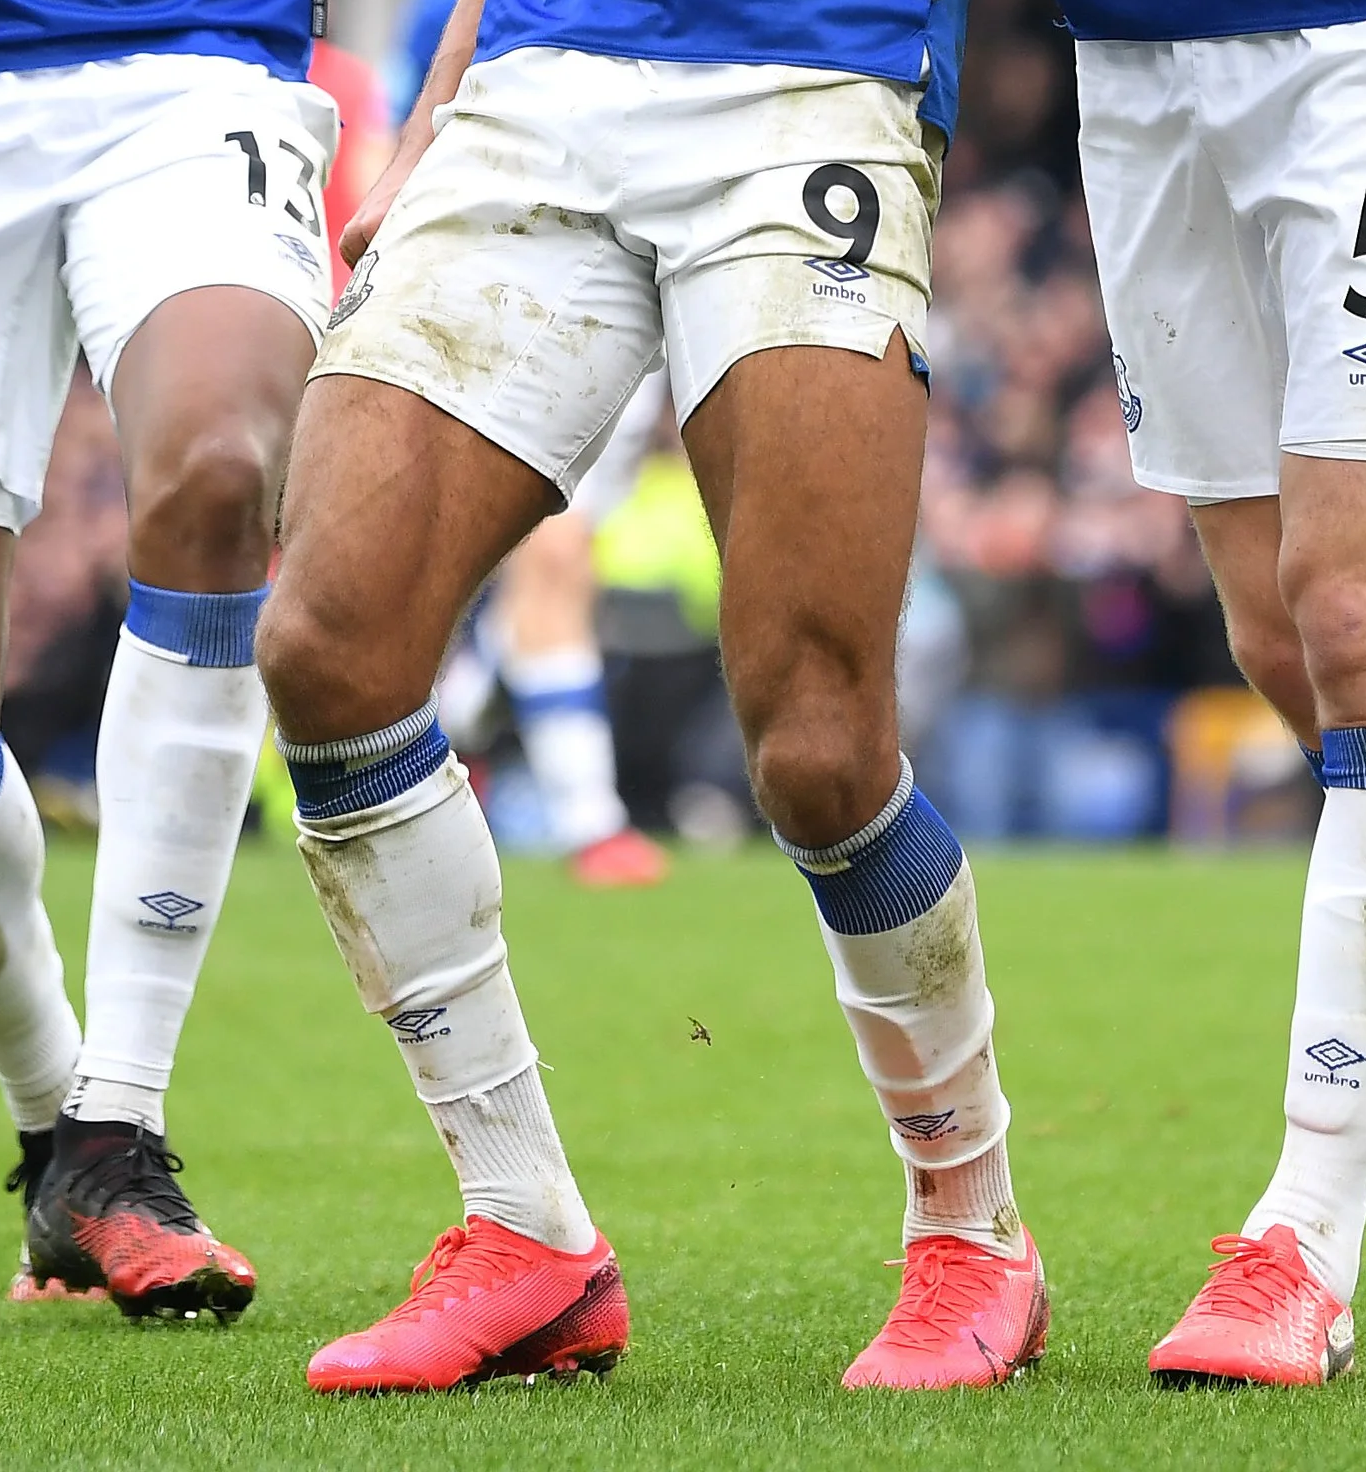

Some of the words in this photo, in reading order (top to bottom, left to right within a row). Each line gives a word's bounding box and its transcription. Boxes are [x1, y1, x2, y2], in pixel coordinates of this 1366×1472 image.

[225, 131, 321, 237] 13
[802, 163, 881, 265] 9
[812, 282, 867, 304] umbro
[1304, 1072, 1360, 1089] umbro
